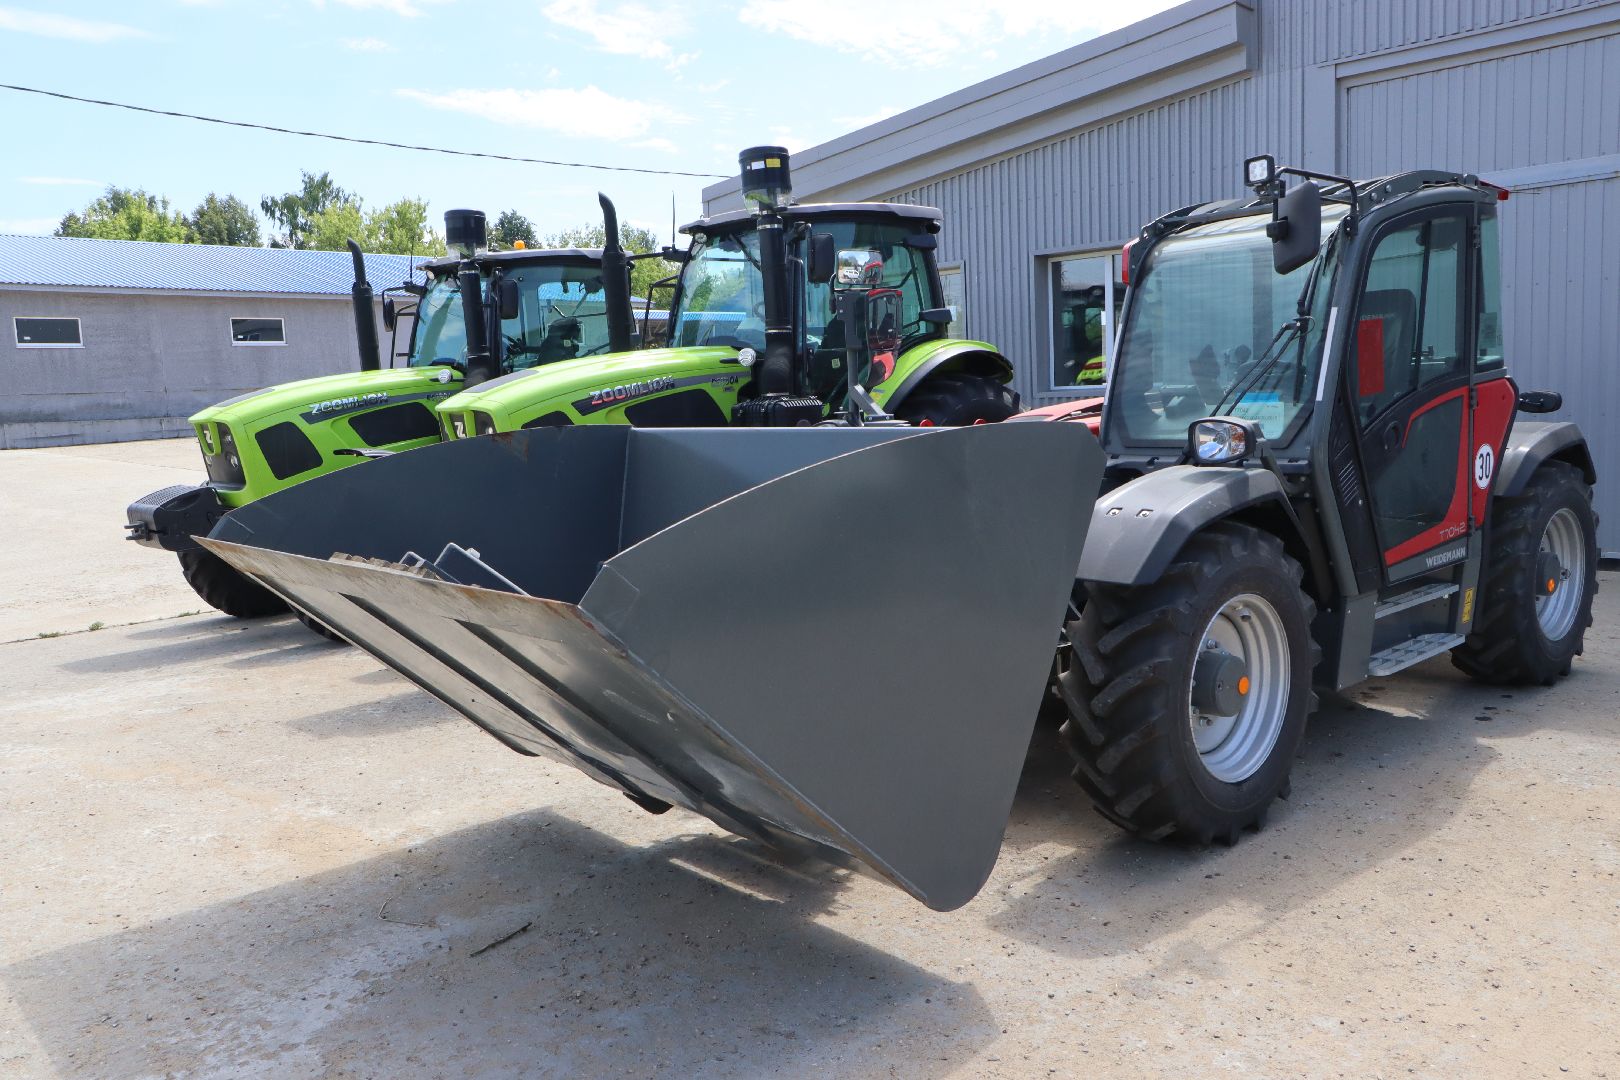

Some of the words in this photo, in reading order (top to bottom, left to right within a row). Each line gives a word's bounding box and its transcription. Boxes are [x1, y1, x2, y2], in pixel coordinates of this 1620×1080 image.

[588, 375, 675, 405] ZOOMLION
[309, 392, 389, 415] ZOOMLION
[1478, 451, 1491, 481] 30
[1440, 521, 1467, 540] T7042
[1426, 546, 1466, 568] WEIDEMANN
